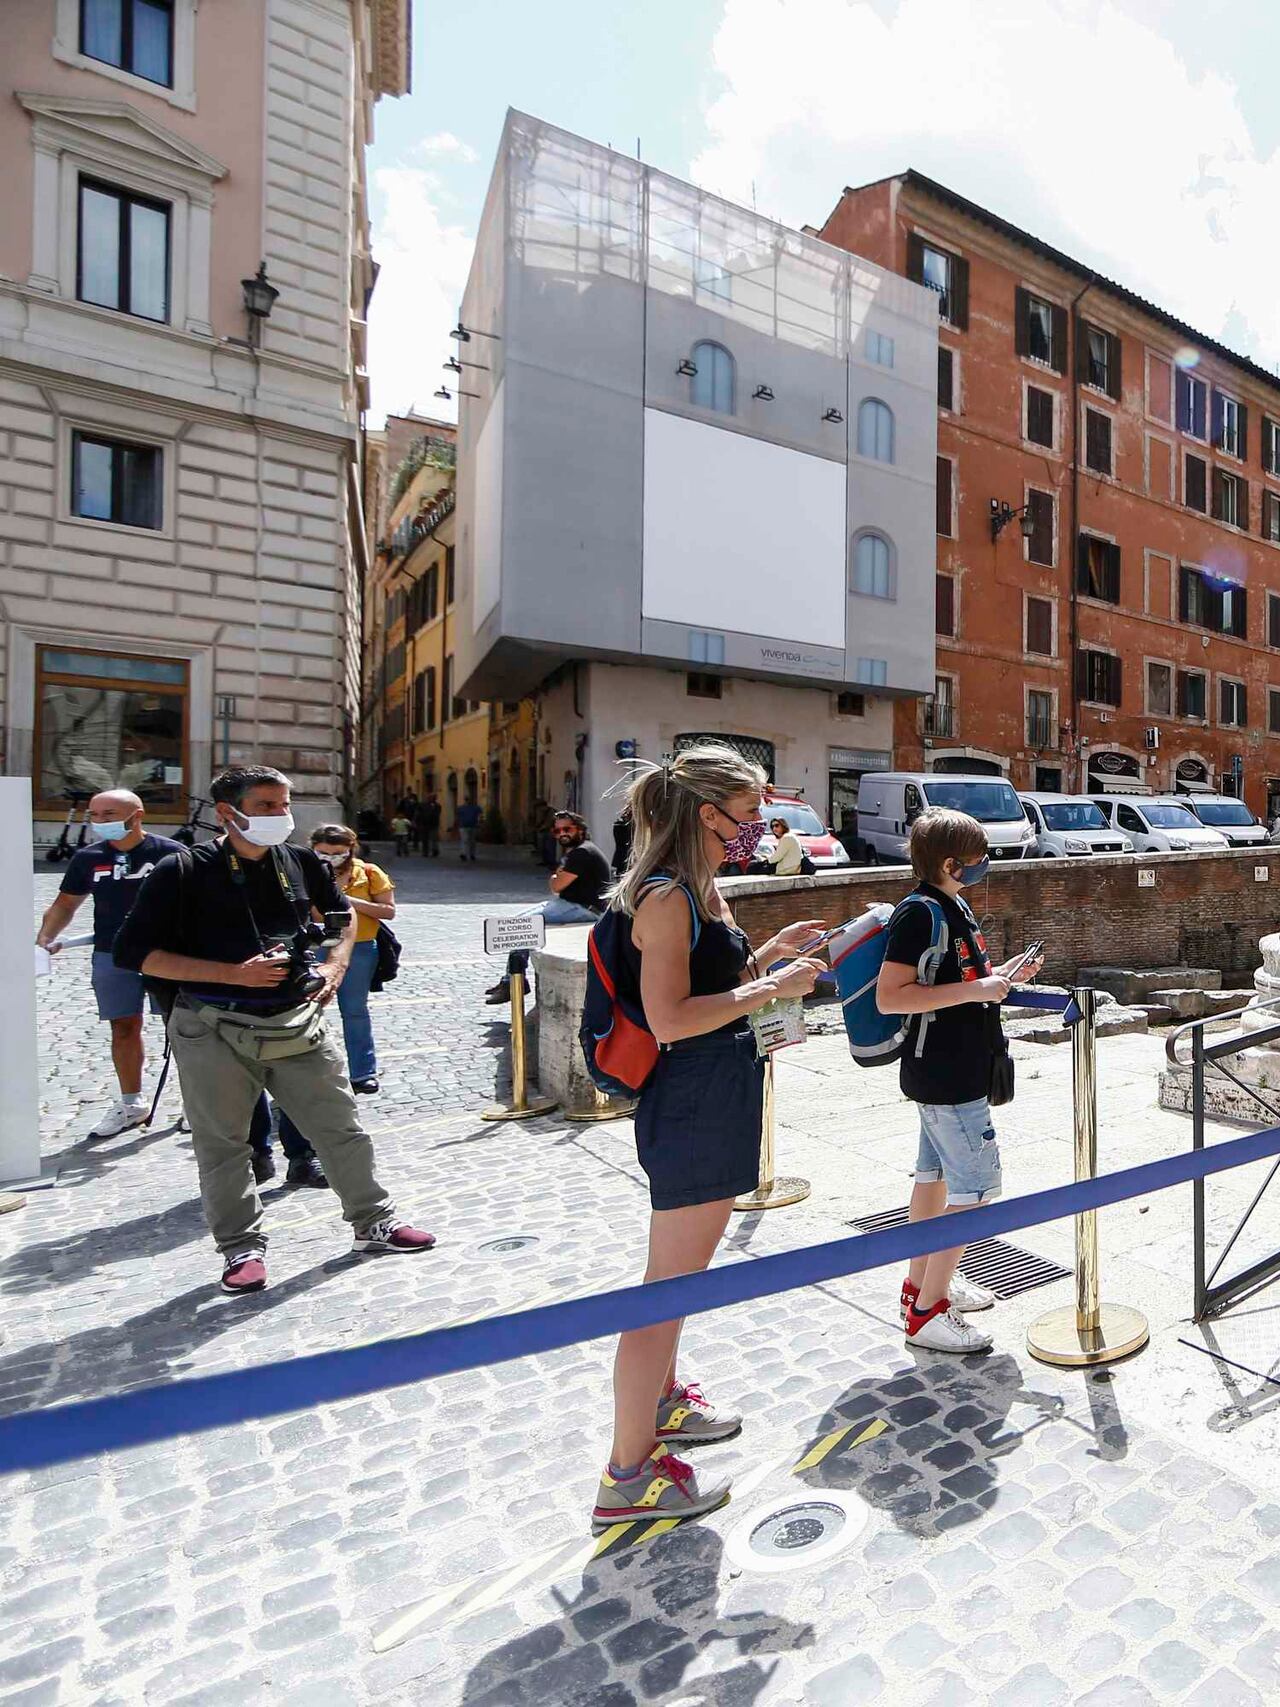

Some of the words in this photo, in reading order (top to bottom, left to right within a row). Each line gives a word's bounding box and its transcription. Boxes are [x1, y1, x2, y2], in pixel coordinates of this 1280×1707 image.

[507, 924, 532, 932] CORSO
[493, 934, 538, 942] CELEBRATION
[502, 940, 538, 948] PROGRESS
